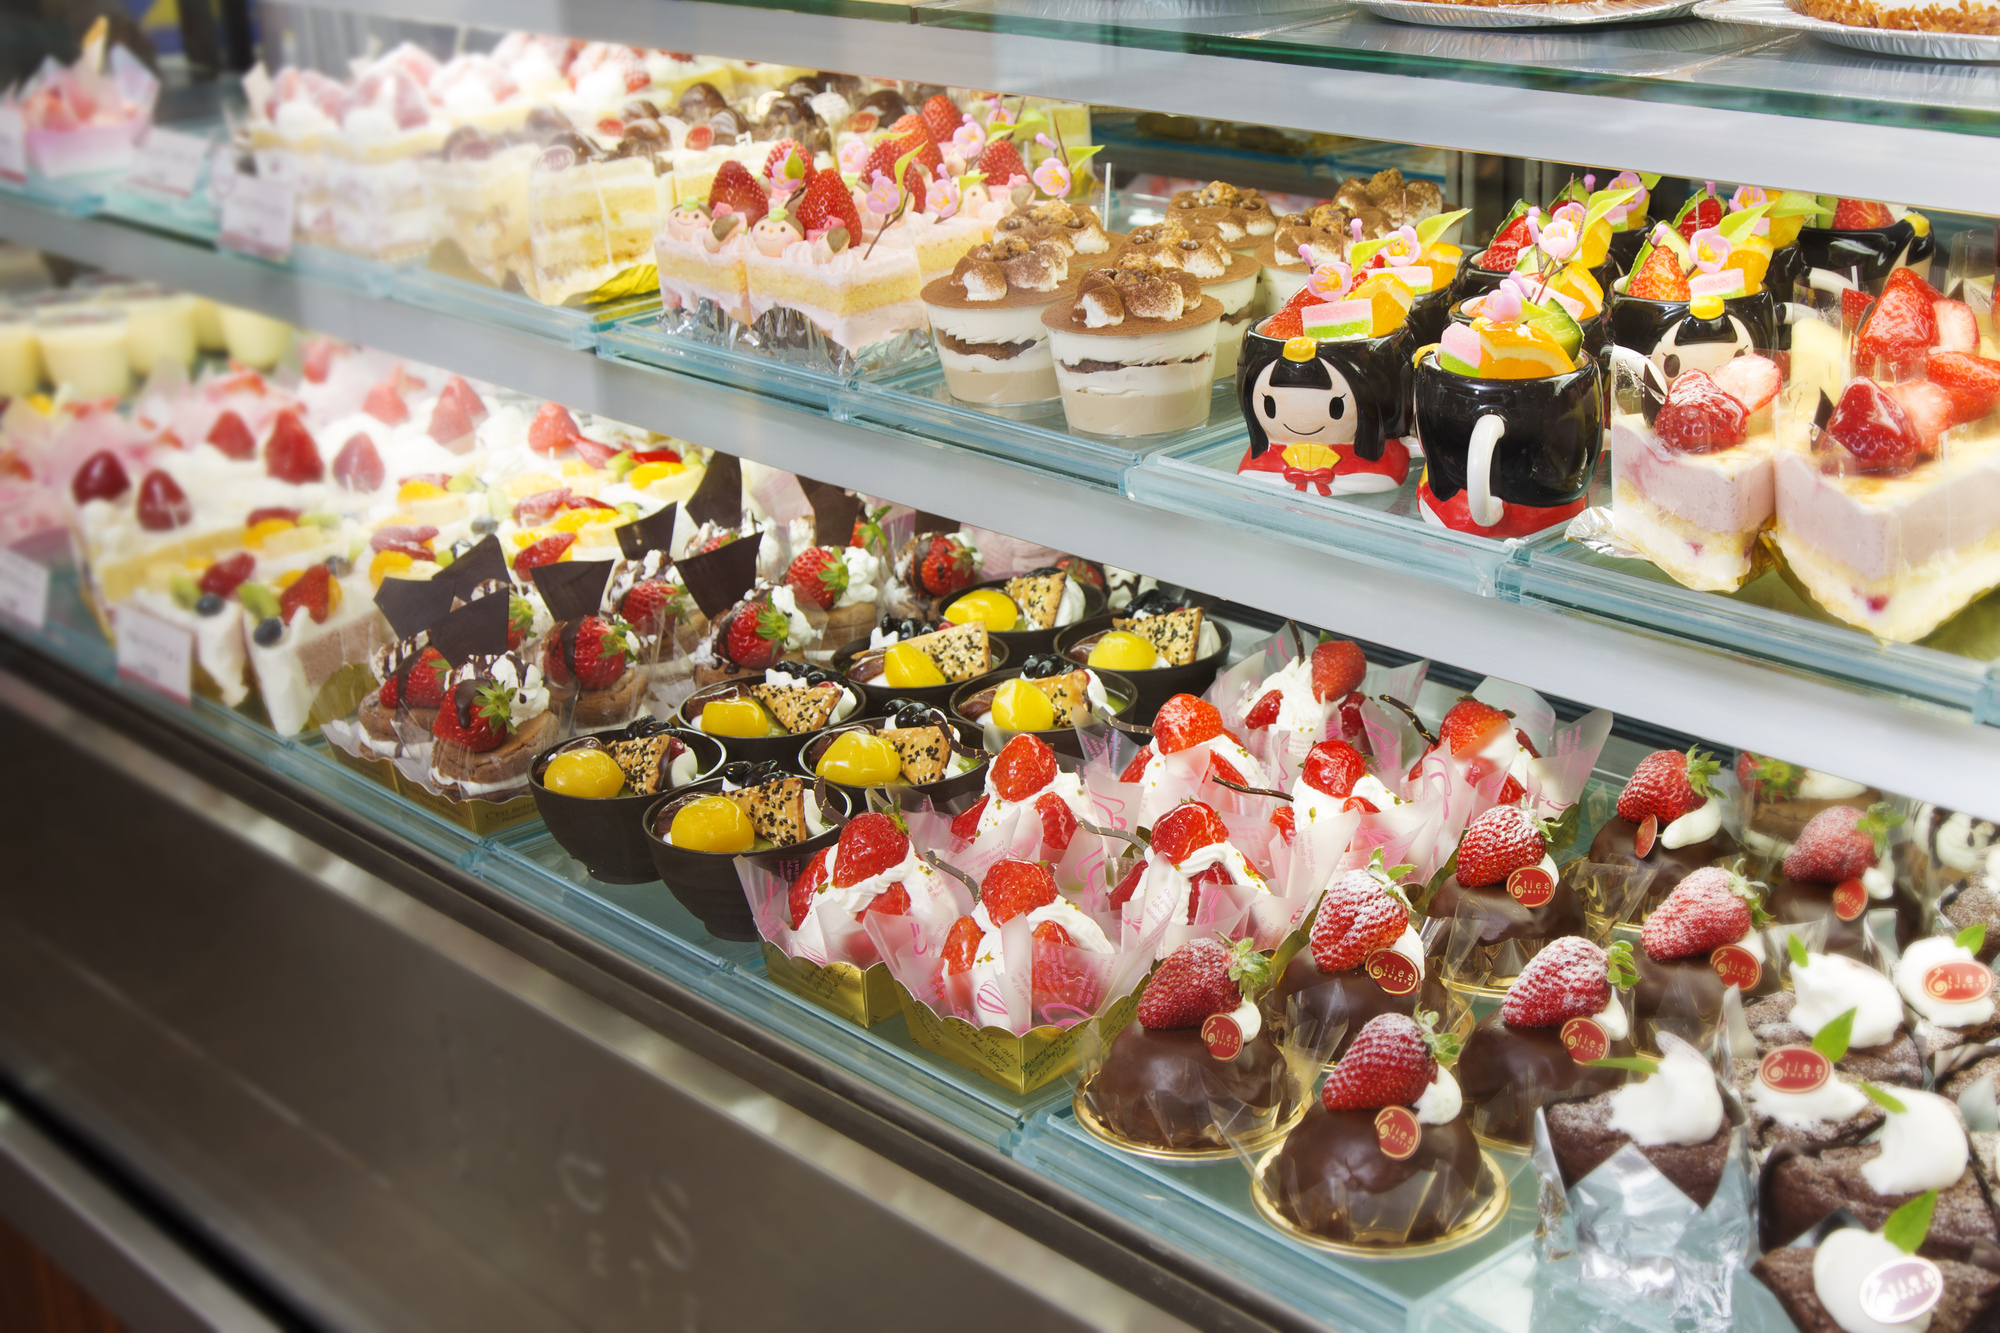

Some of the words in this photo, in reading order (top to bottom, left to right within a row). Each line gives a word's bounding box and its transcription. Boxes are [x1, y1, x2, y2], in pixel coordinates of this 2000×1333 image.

[1523, 880, 1550, 890] ties
[1384, 963, 1414, 981] ties
[1728, 960, 1756, 976] ties
[1947, 974, 1986, 985] ties
[1216, 1029, 1239, 1044] ties
[1578, 1033, 1605, 1051] ties
[1785, 1061, 1823, 1074] ties
